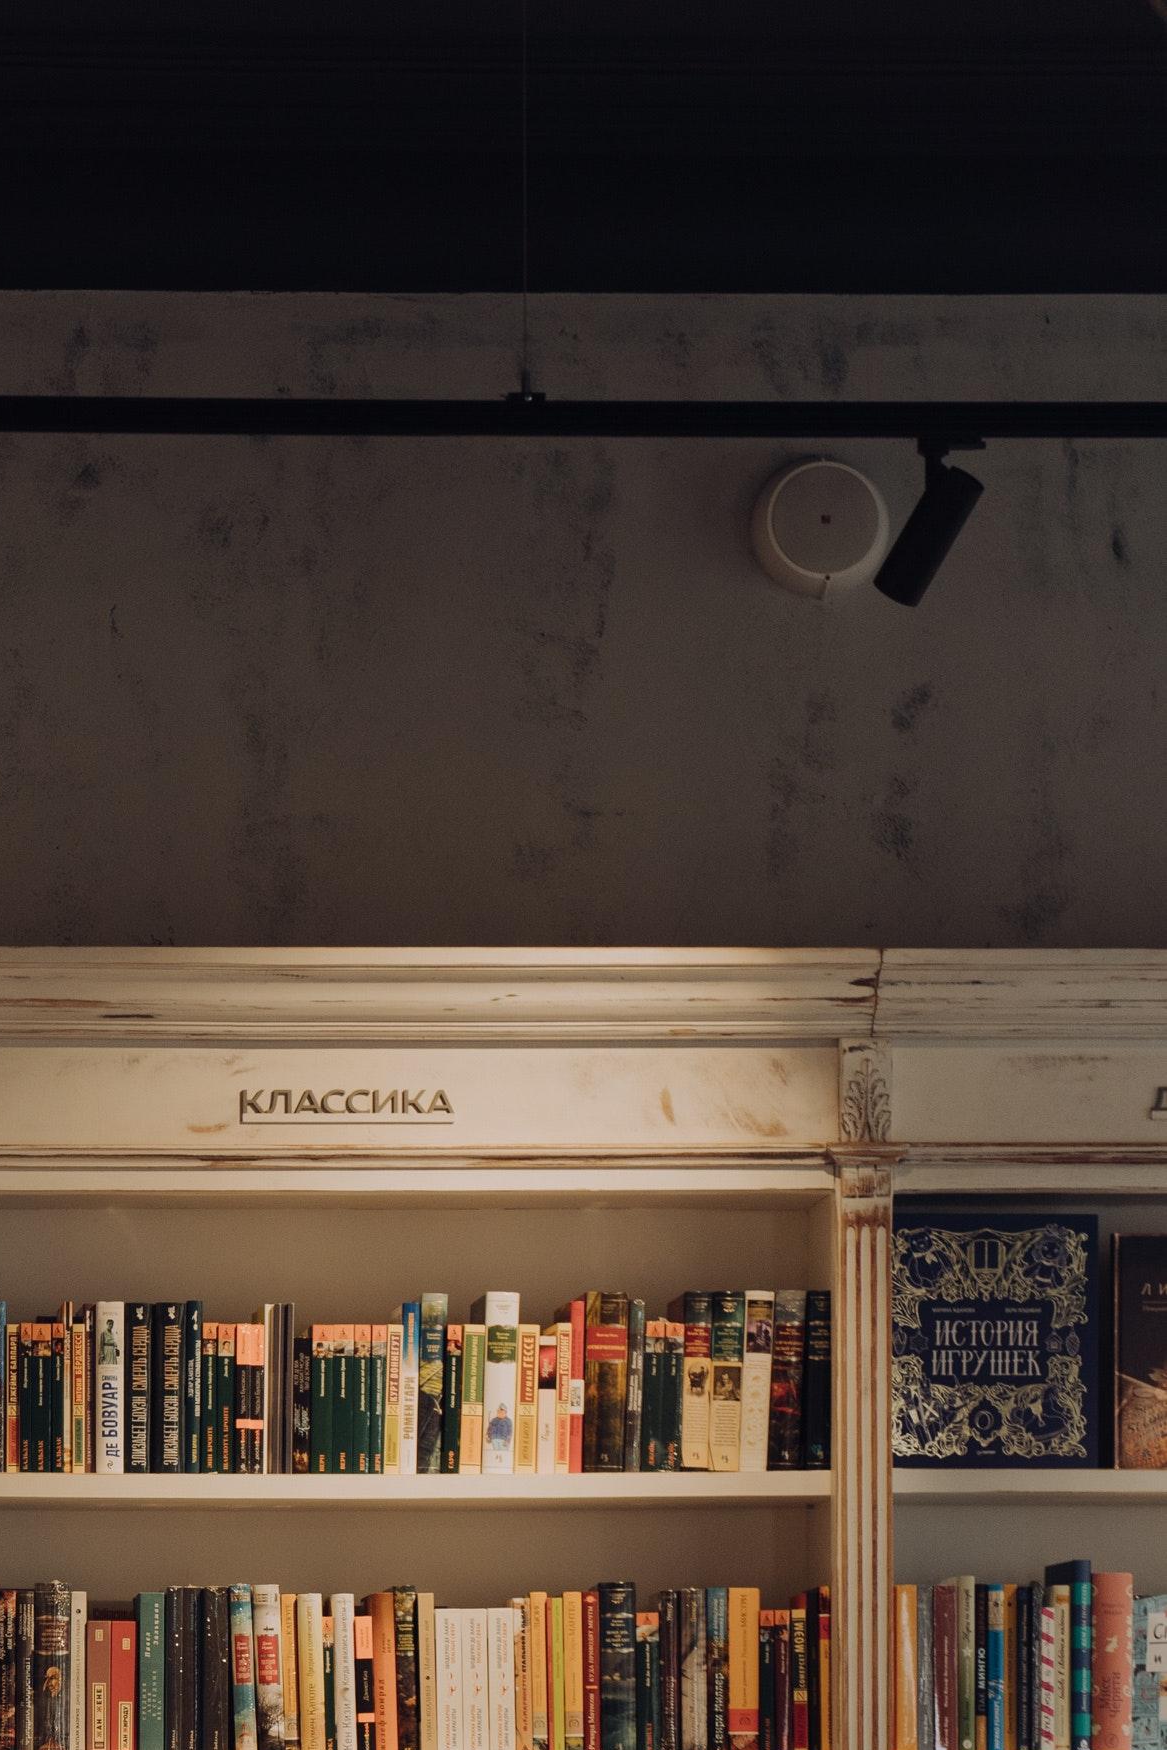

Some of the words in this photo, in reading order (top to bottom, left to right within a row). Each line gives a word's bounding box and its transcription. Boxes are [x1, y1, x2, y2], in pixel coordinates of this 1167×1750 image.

[239, 1089, 454, 1114] КЛАССИКА
[133, 1325, 149, 1355] СЕРДЦА
[165, 1325, 181, 1355] СЕРДЦА
[935, 1321, 1039, 1346] ИСТОРИЯ
[389, 1335, 398, 1379] ВОННЕГУТ
[520, 1337, 533, 1368] ГЕССЕ
[932, 1351, 1042, 1376] ИГРУШЕК
[133, 1358, 146, 1390] СМЕРТЬ
[164, 1357, 178, 1390] СМЕРТЬ
[403, 1376, 415, 1401] ГАРИ
[389, 1382, 398, 1401] КУРТ
[102, 1382, 117, 1438] БОВУАР
[132, 1396, 146, 1421] БОУЭН
[164, 1396, 178, 1421] БОУЭН
[403, 1404, 414, 1440] РОМЕН
[106, 1443, 120, 1457] ДЕ
[132, 1424, 147, 1465] ЭЛИЗАБЕТ
[164, 1424, 178, 1465] ЭЛИЗАБЕТ
[794, 1623, 804, 1653] МОЭМ
